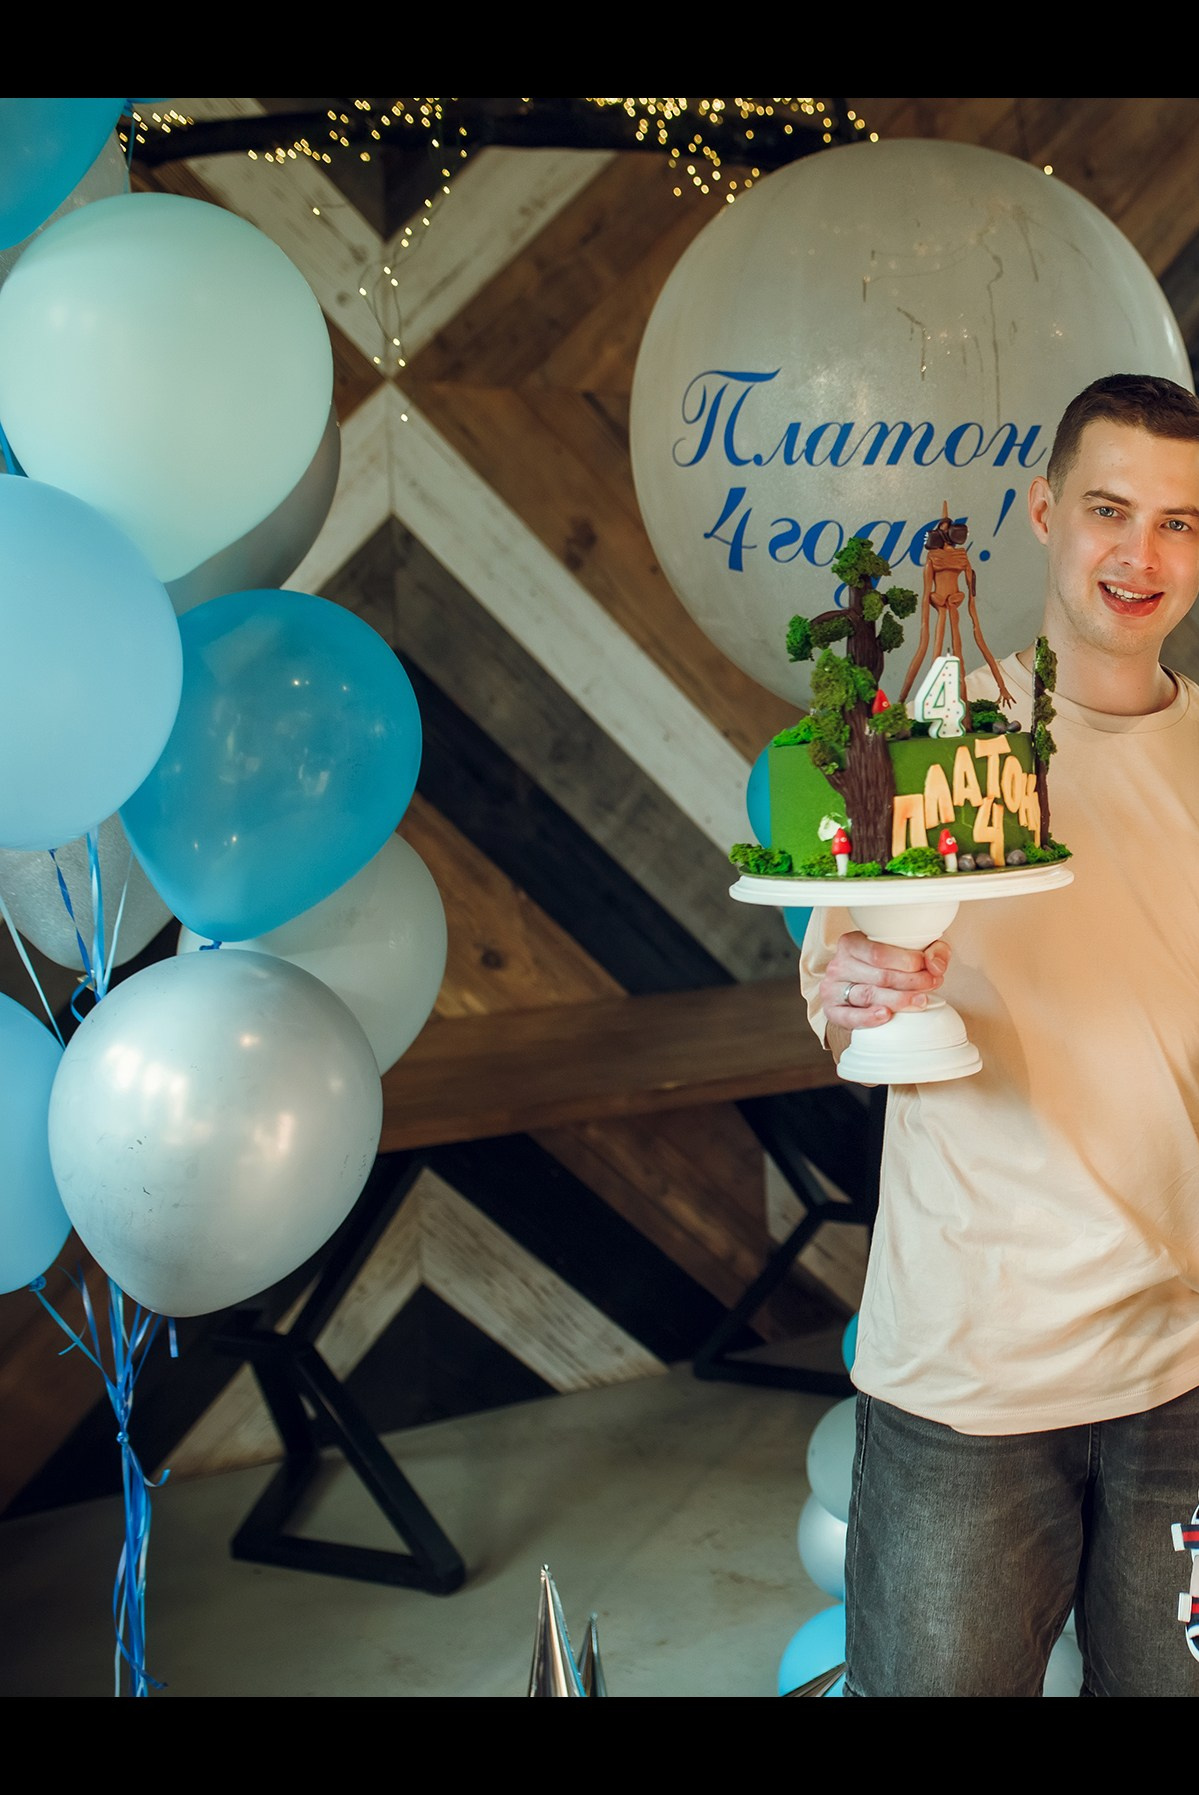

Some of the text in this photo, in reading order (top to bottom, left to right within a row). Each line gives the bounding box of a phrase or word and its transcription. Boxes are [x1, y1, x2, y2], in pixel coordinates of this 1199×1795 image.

[672, 367, 1047, 468] Платон
[703, 486, 758, 573] 4
[915, 655, 967, 739] 4
[973, 796, 1006, 867] 4
